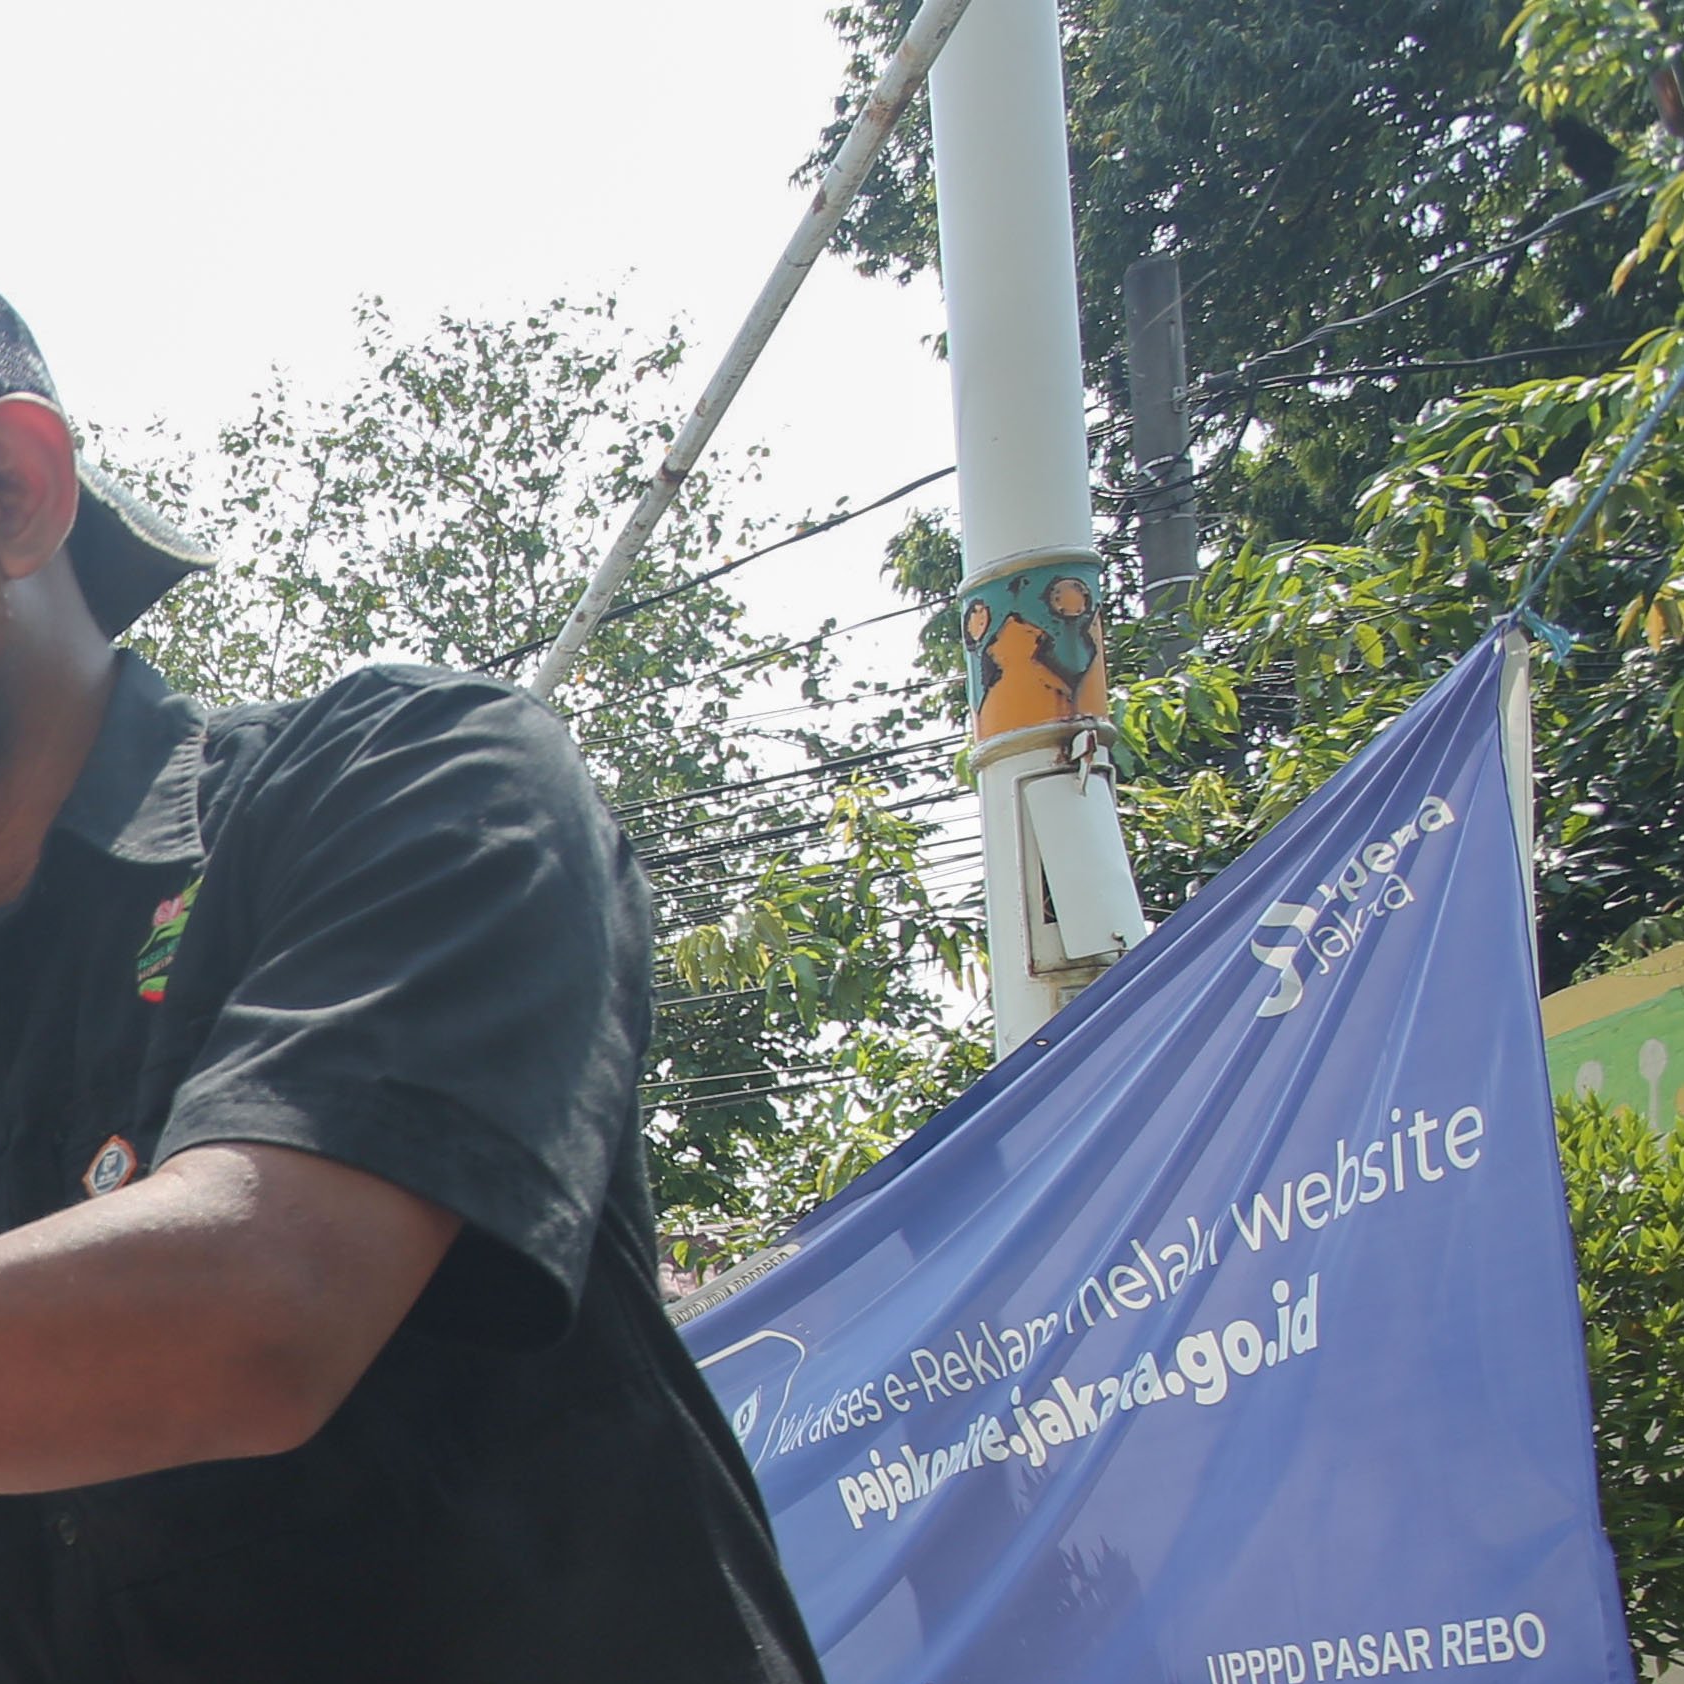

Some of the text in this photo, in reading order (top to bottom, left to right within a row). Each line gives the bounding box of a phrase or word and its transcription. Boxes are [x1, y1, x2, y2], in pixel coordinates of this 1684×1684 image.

[808, 1382, 883, 1443] akses
[1231, 1104, 1483, 1252] website
[1312, 1627, 1434, 1683] PASAR
[1440, 1611, 1547, 1668] REBO
